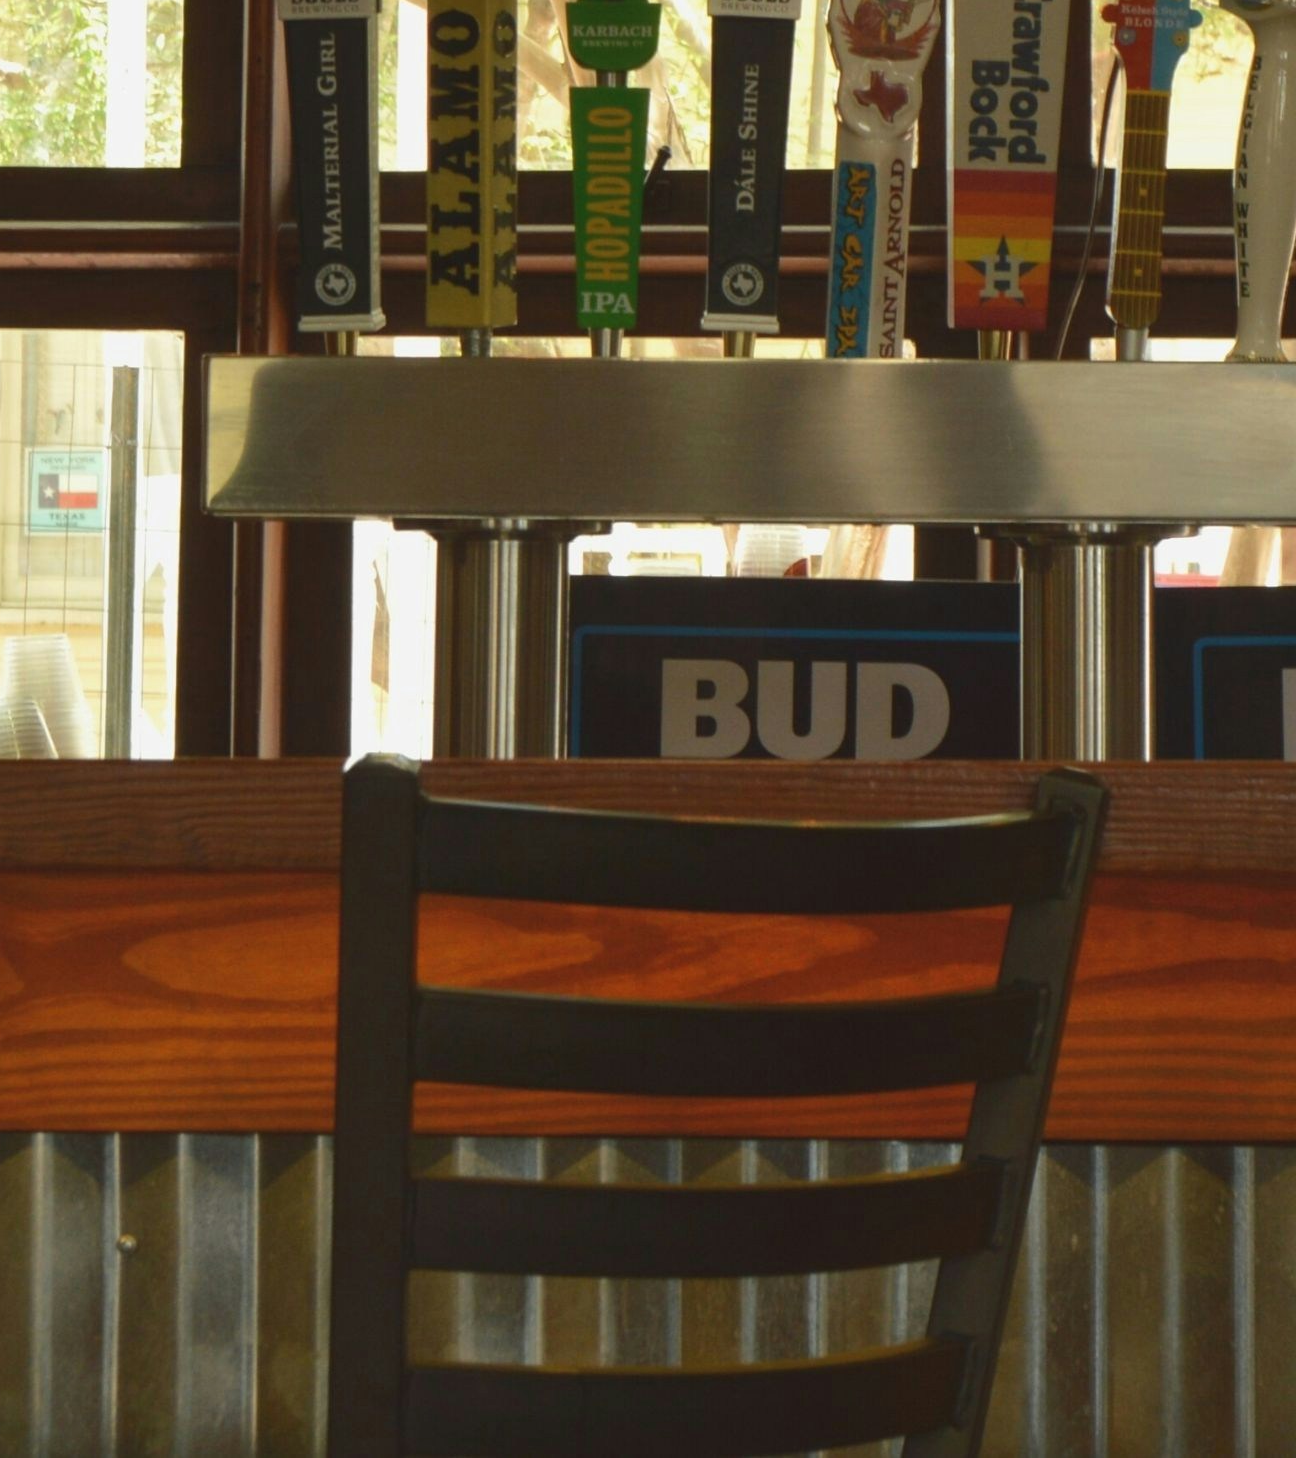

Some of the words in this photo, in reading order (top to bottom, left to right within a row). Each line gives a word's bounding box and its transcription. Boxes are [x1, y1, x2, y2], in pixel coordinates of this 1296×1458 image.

[572, 24, 653, 37] KARBACH
[1124, 16, 1185, 29] BLONDE
[429, 9, 480, 296] ALAMO
[968, 59, 1009, 163] Bock
[1236, 55, 1262, 190] BELGIAN
[584, 105, 634, 284] HOPADILLO
[845, 169, 871, 225] ART
[883, 158, 906, 278] ARNOLD
[840, 233, 865, 291] CAR
[1236, 203, 1251, 298] WHITE
[580, 292, 635, 315] IPA
[879, 277, 899, 358] SAINT
[659, 658, 951, 761] BUD
